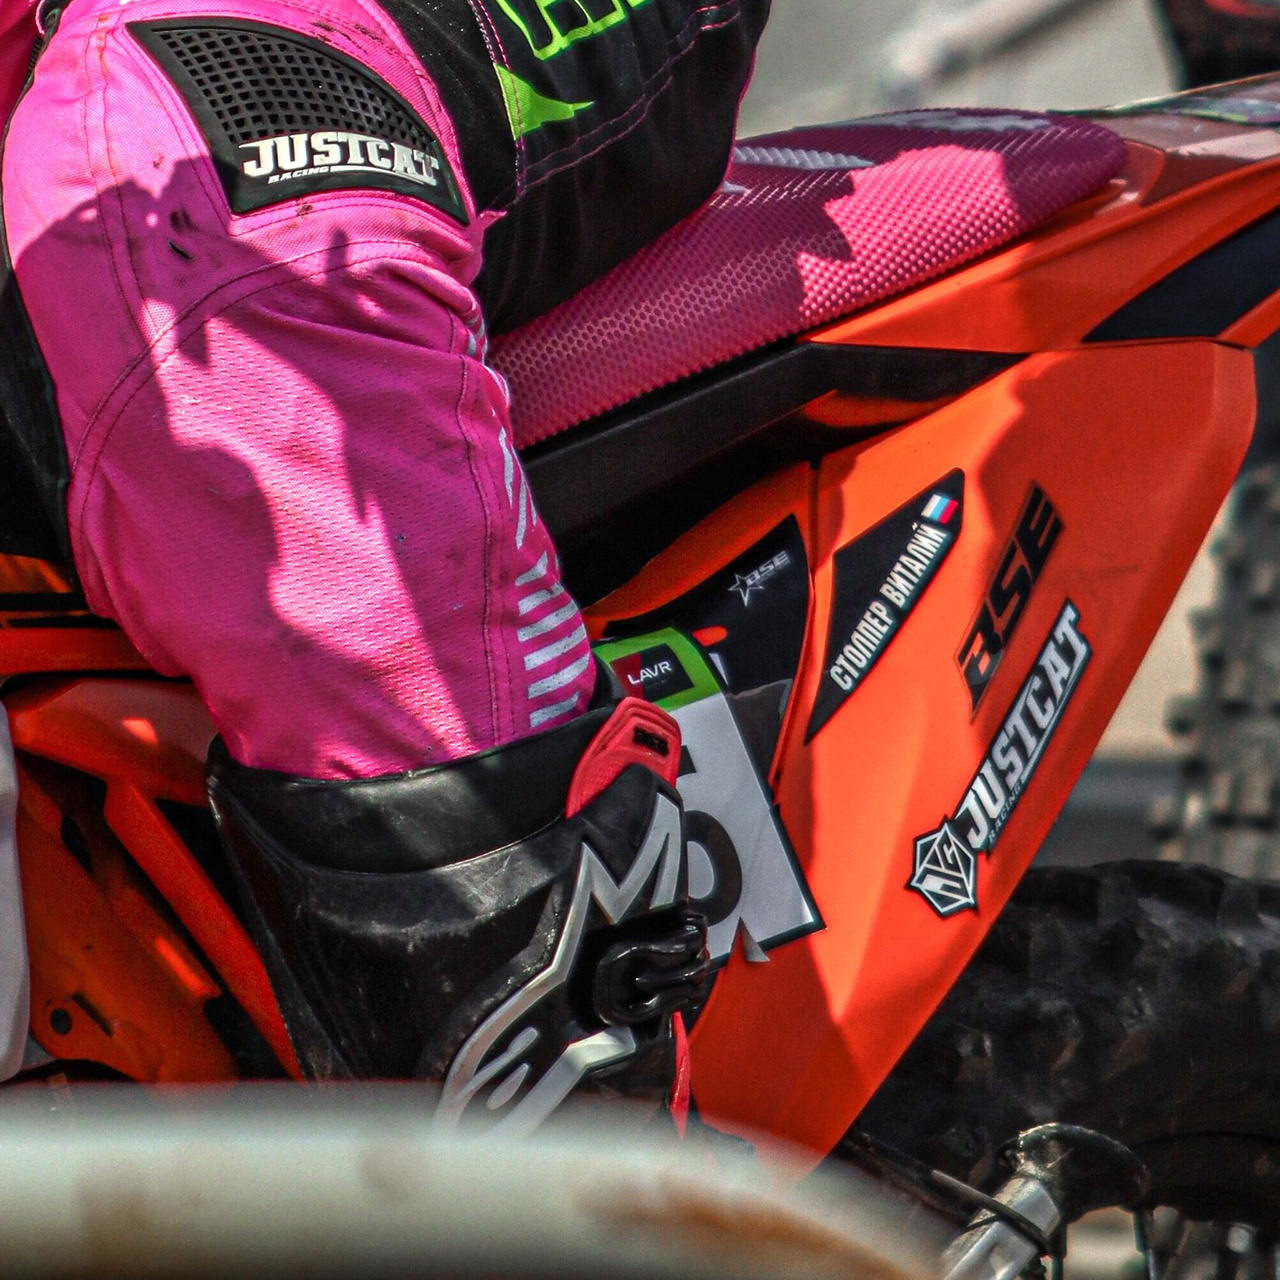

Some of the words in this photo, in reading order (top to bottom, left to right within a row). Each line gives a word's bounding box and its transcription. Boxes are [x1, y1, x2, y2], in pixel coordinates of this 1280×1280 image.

[238, 131, 440, 187] JUSTCAT
[267, 166, 330, 185] RACING
[879, 521, 948, 610] ВИТАЛИЙ
[956, 482, 1065, 715] BSE
[627, 660, 673, 686] LAVR
[951, 602, 1089, 849] JUSTCAT
